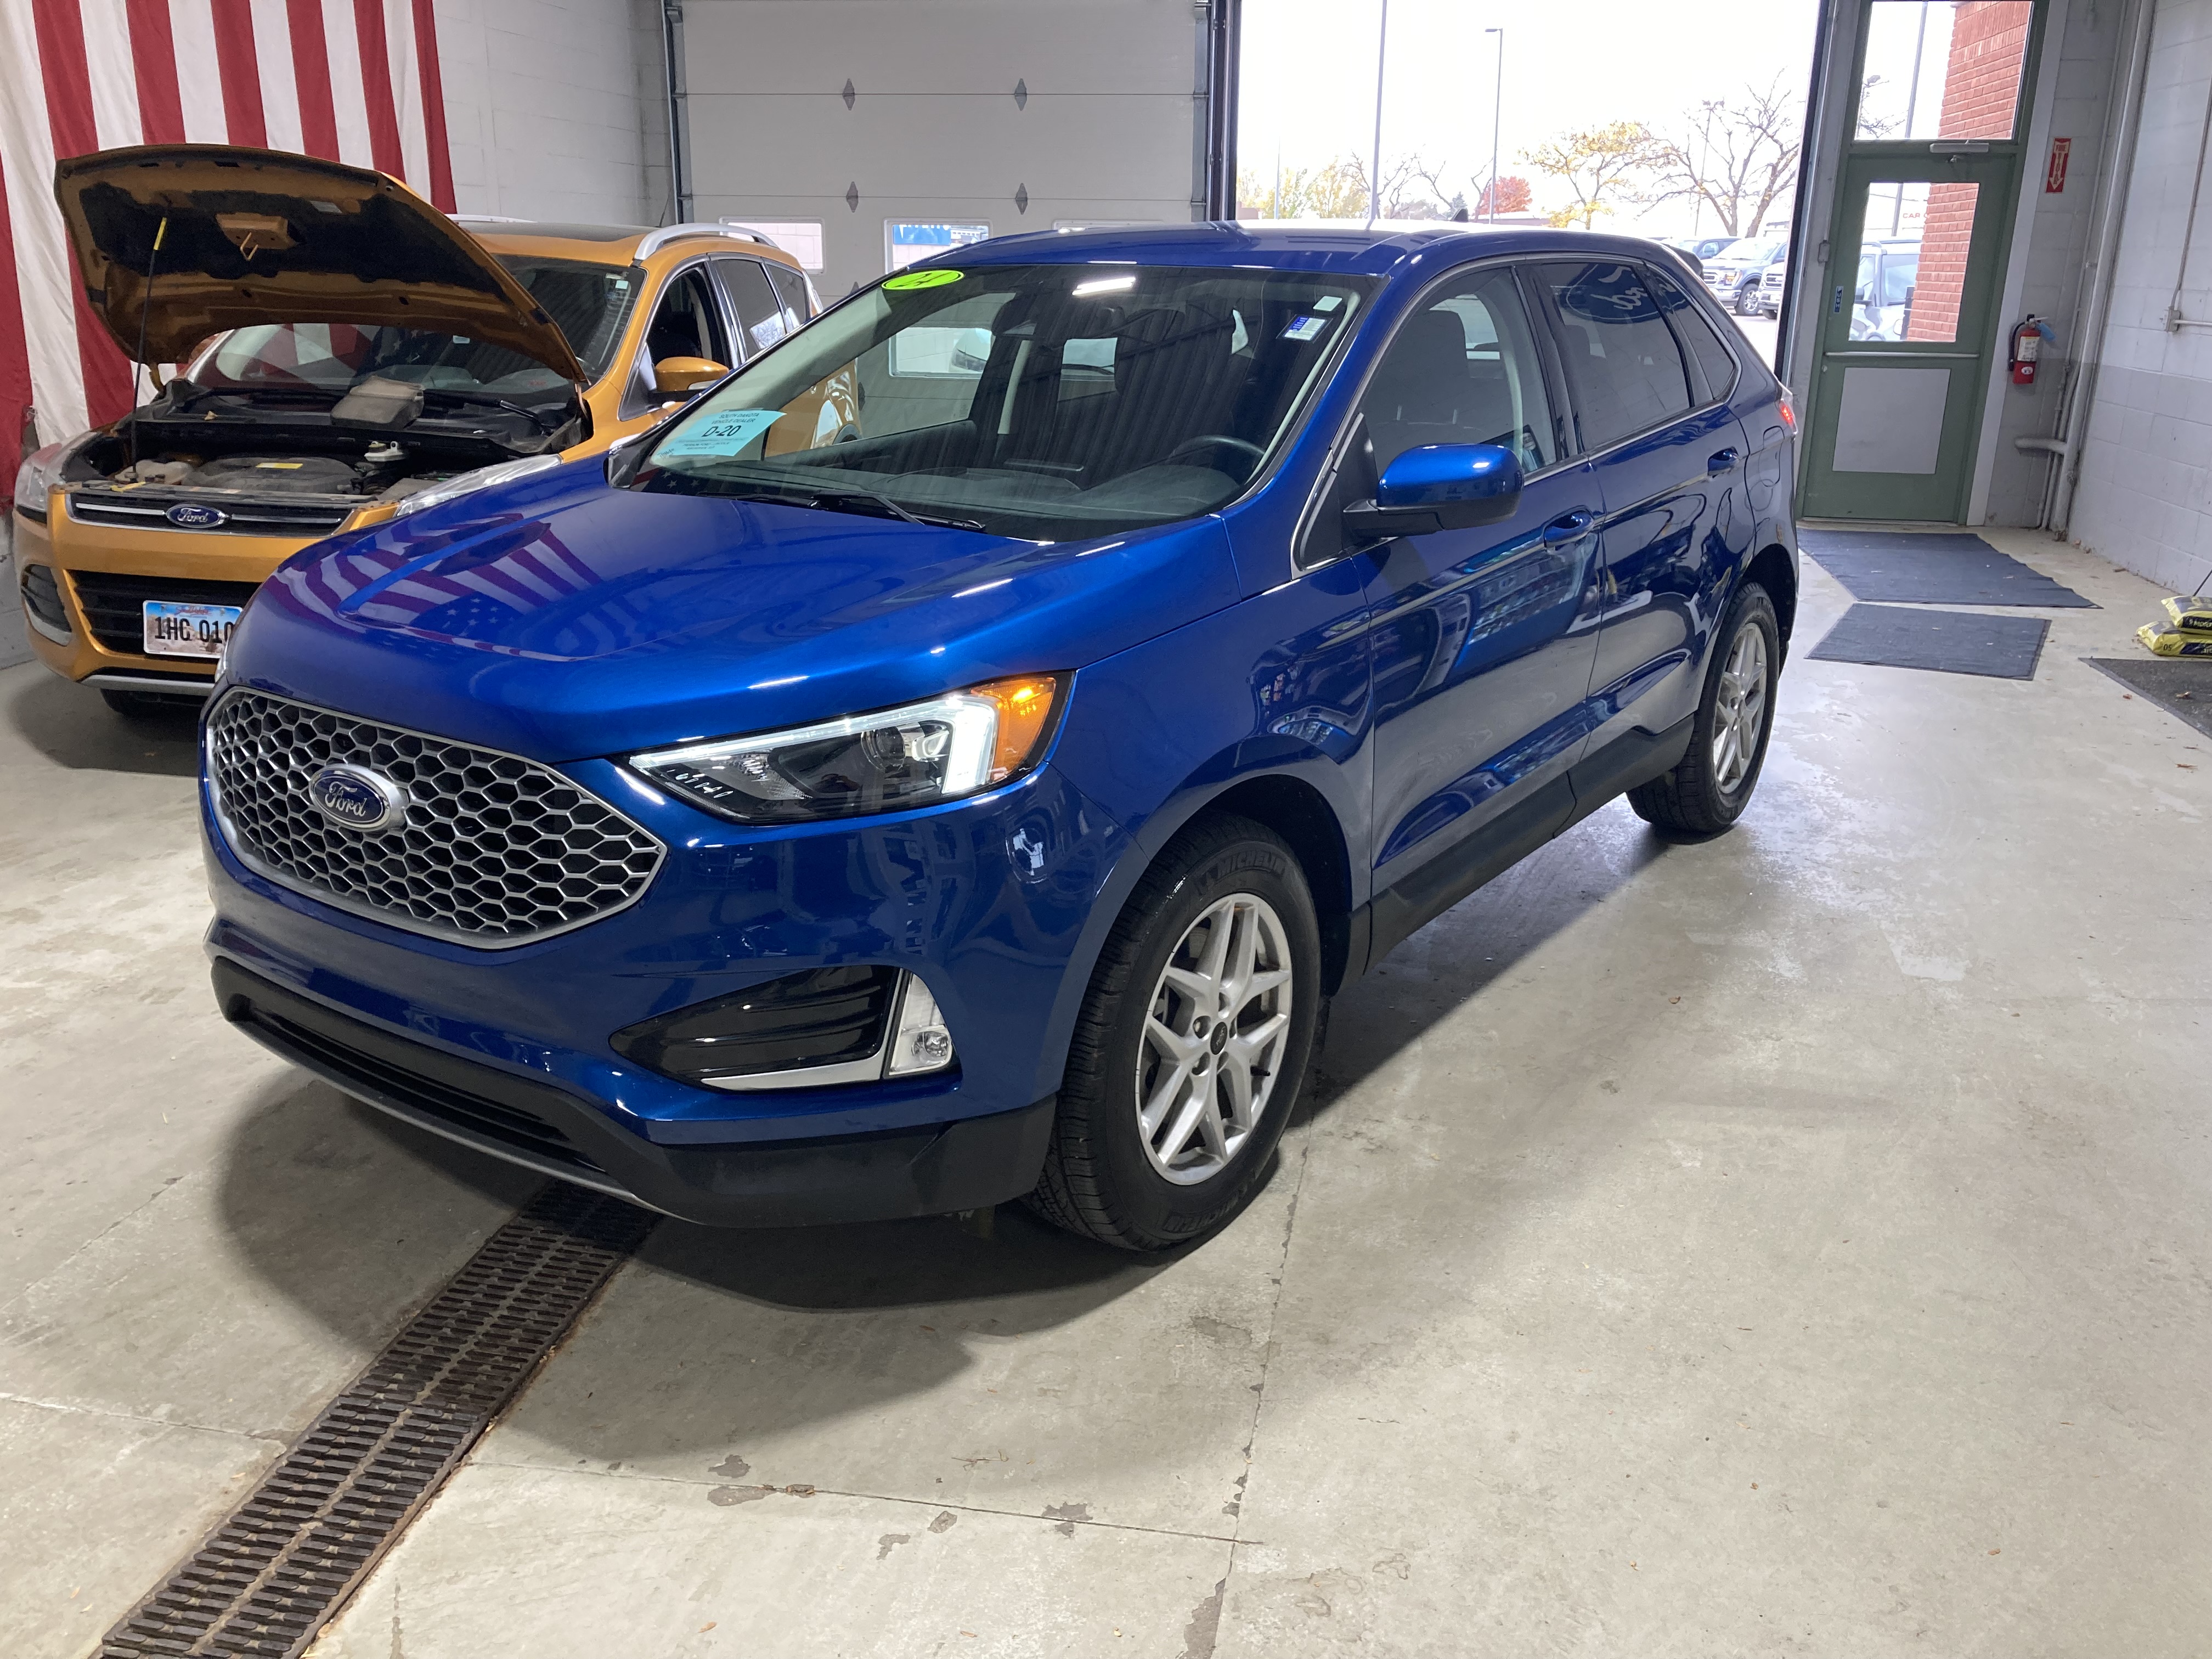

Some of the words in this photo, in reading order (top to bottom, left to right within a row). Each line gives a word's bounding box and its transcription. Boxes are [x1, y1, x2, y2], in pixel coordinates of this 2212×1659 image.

[701, 425, 742, 437] D-20
[177, 507, 208, 522] Ford
[154, 616, 191, 641] 1HC
[325, 781, 368, 817] Ford
[1217, 851, 1285, 879] MICHELIN
